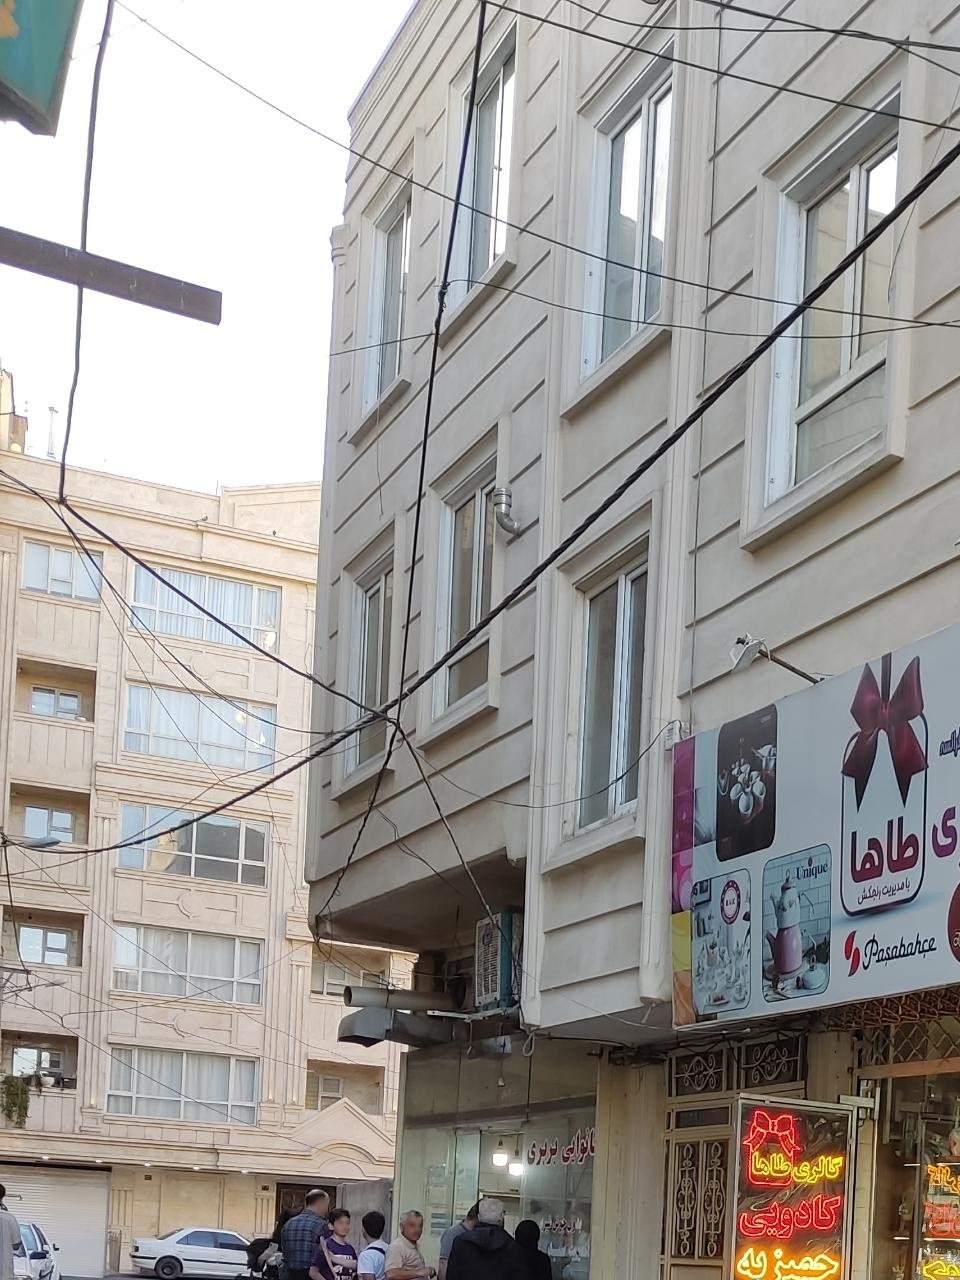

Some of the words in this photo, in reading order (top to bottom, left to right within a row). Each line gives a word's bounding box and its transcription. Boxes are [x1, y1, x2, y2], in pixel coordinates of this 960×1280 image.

[850, 817, 920, 883] طاها
[796, 856, 828, 881] Unique
[882, 882, 905, 898] مدیریت
[905, 877, 911, 893] با
[862, 932, 937, 971] Paşabahçe
[527, 1136, 559, 1166] بربری
[751, 1150, 792, 1178] طاها
[792, 1154, 844, 1184] گالری
[738, 1193, 841, 1239] کادویی
